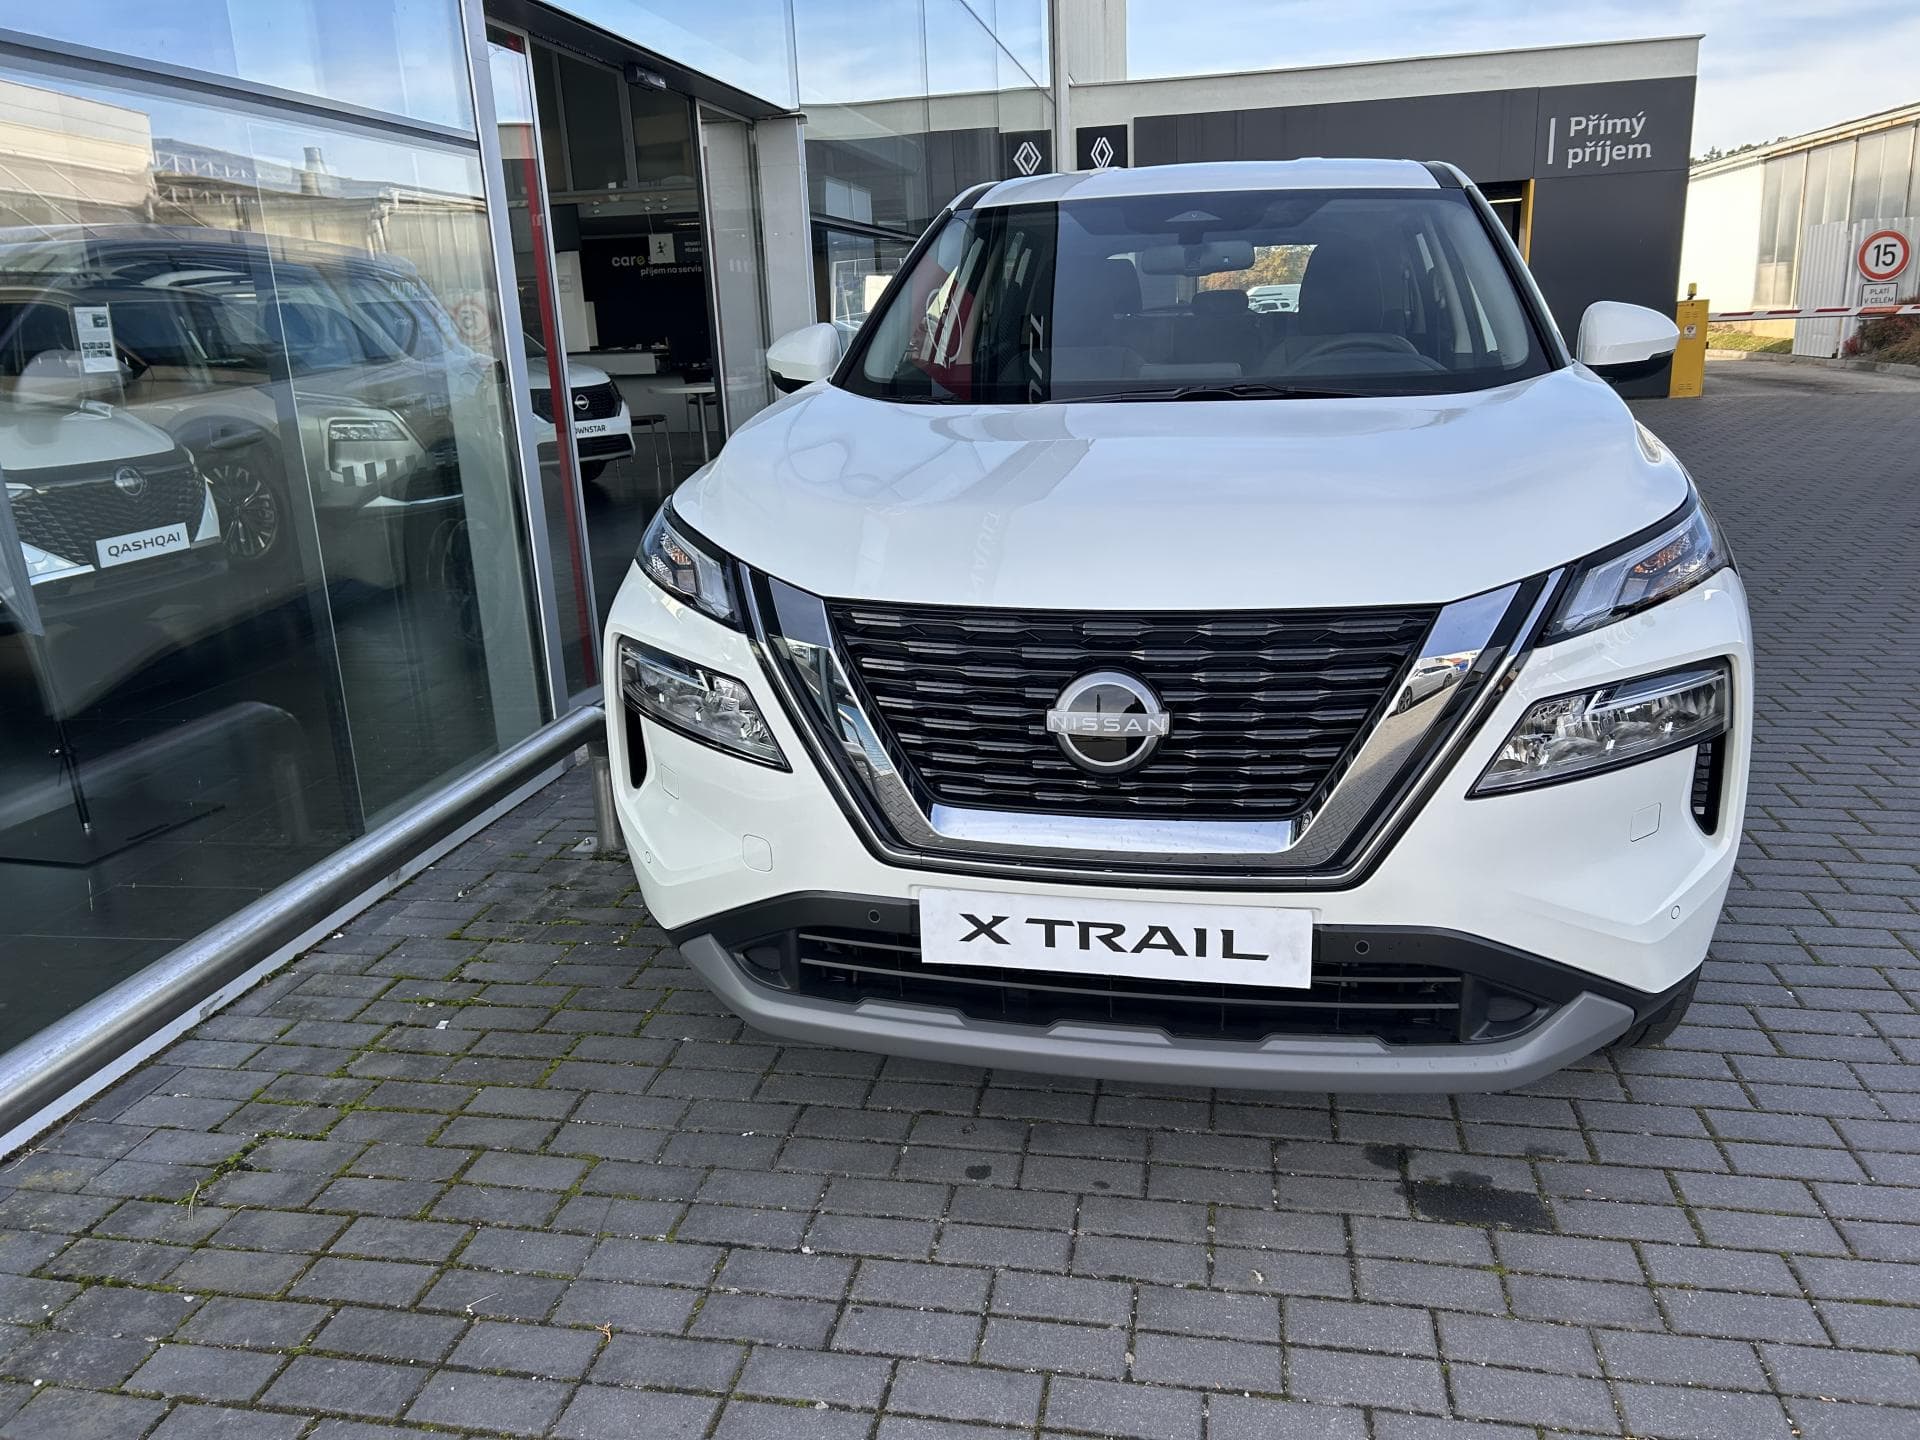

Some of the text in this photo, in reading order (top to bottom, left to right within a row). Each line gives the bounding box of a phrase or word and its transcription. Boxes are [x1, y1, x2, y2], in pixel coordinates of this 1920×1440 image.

[1569, 111, 1647, 138] Přímý
[1567, 140, 1652, 169] příjem
[611, 255, 646, 267] care
[1873, 243, 1897, 267] 15
[678, 264, 702, 274] servis
[575, 424, 607, 435] WNSTAR
[107, 531, 181, 558] QASHQAI
[1050, 715, 1166, 733] NISSAN
[958, 912, 1270, 962] X TRAIL
